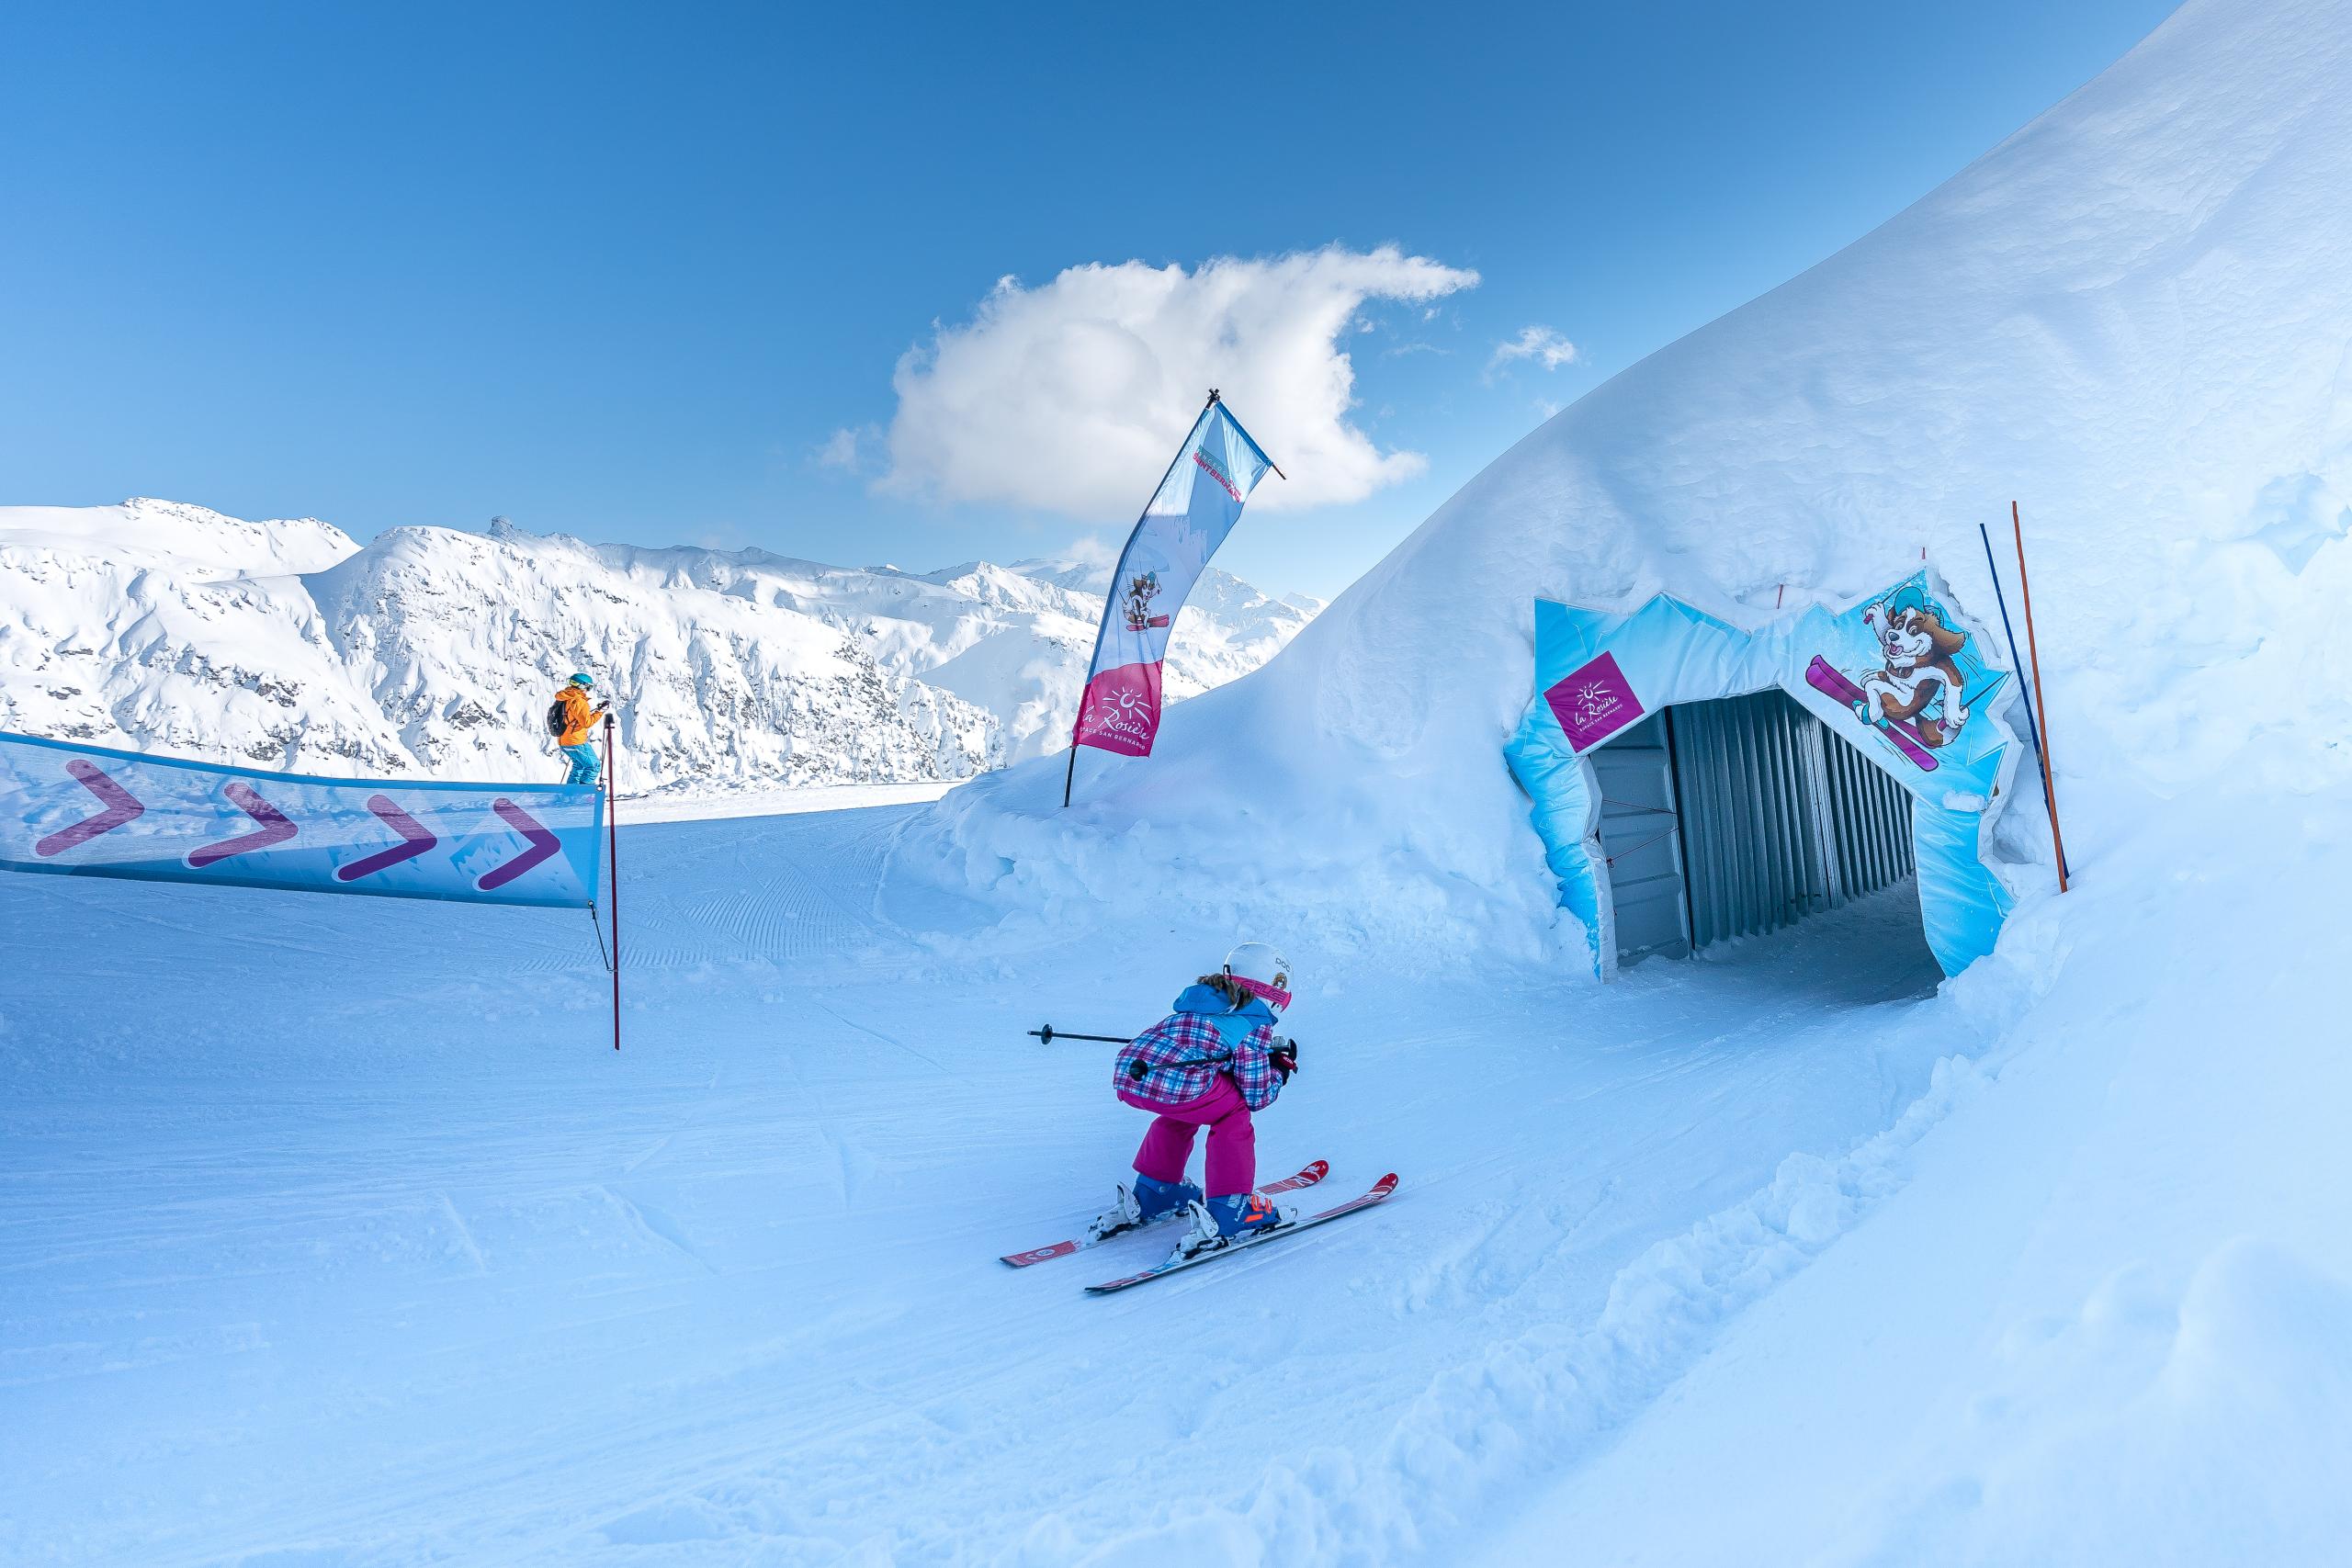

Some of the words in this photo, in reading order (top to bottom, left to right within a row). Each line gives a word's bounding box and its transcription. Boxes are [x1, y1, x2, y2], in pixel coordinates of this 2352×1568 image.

[1098, 705, 1150, 739] Rosière
[1575, 712, 1587, 726] la
[1581, 696, 1619, 721] Rosière
[1275, 957, 1291, 973] POC
